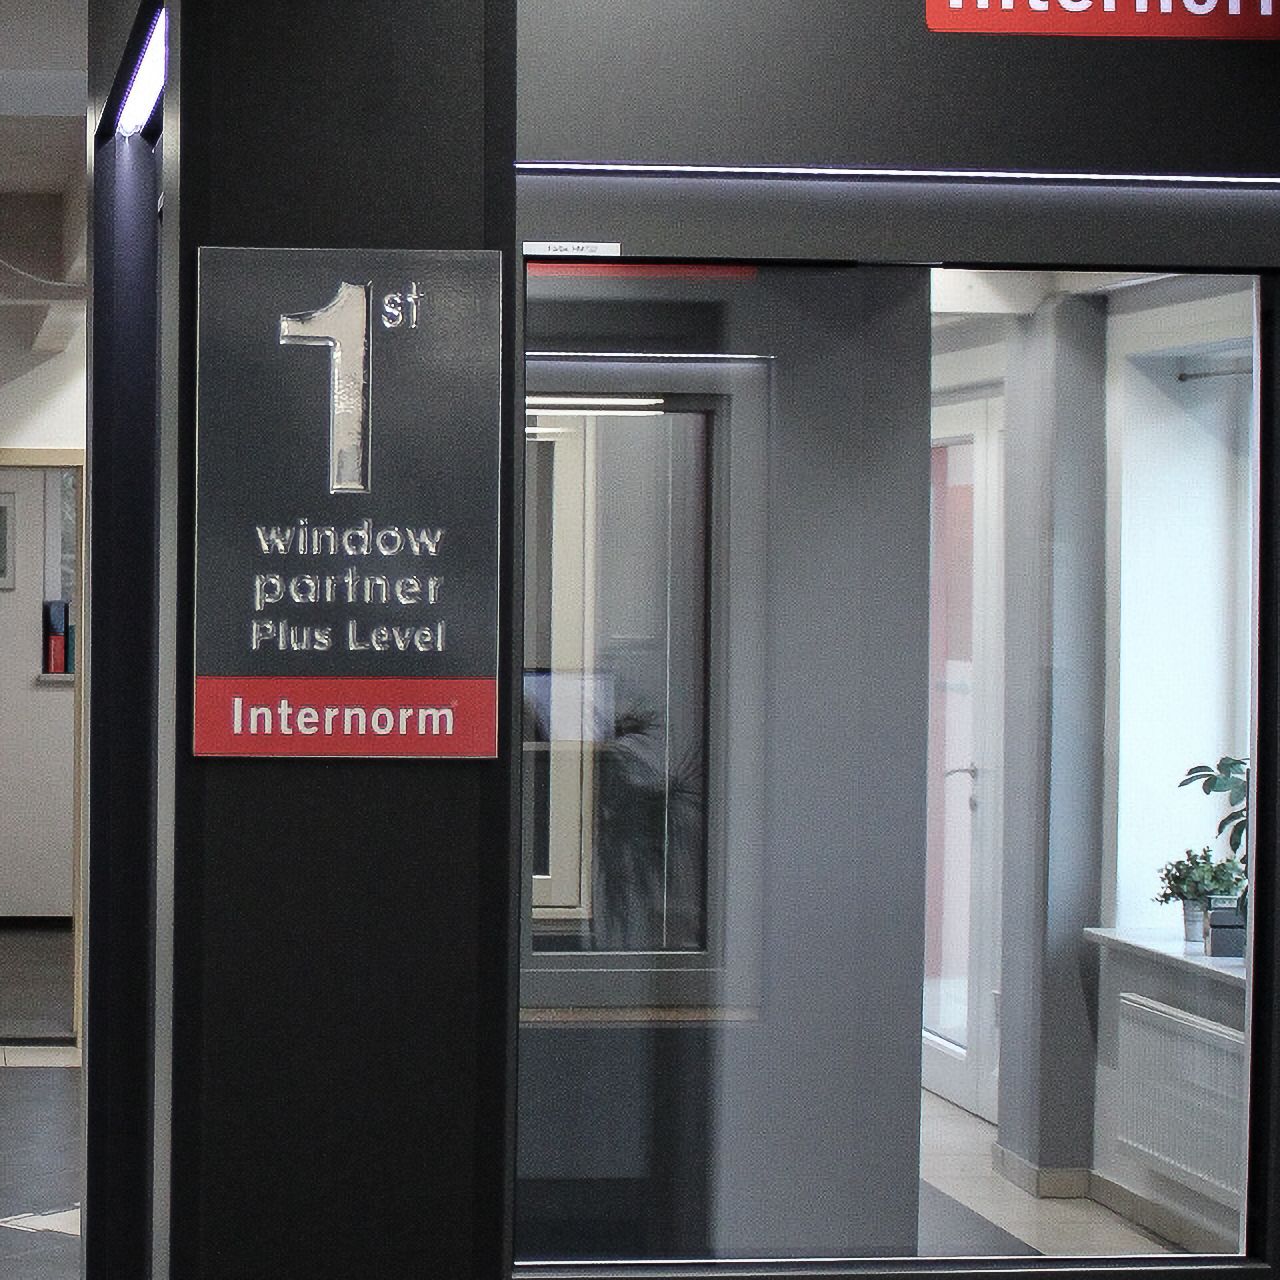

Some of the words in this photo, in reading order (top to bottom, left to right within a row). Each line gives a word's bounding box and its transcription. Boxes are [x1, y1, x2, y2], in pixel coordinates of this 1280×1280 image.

[255, 518, 447, 556] window
[254, 566, 445, 612] partner
[251, 620, 333, 651] Plus
[348, 620, 447, 651] Level
[232, 696, 454, 735] Internorm
